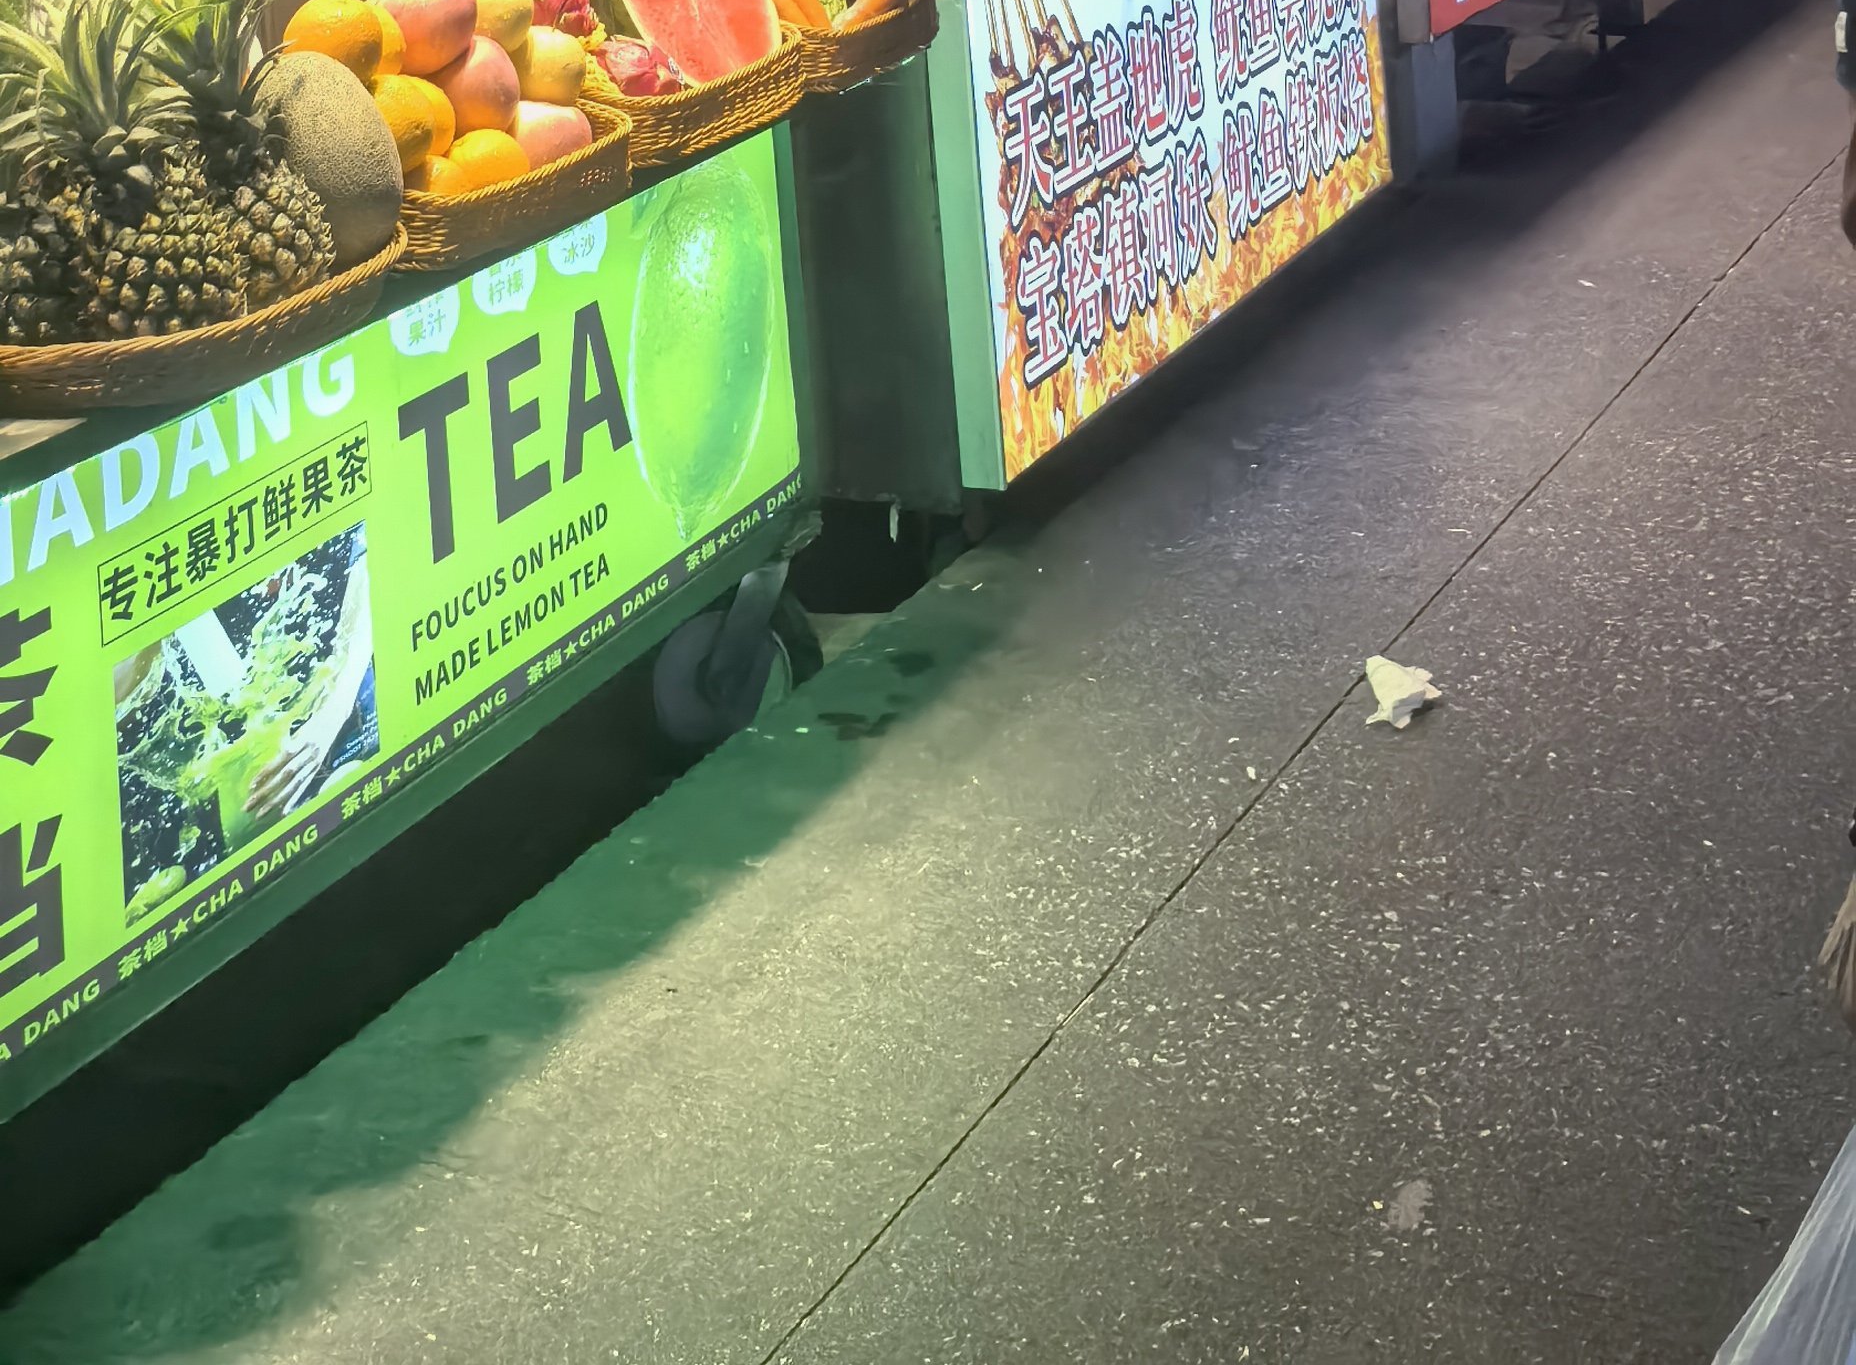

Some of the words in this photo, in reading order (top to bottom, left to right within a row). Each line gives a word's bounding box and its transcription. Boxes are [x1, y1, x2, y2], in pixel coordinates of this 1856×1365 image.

[562, 233, 595, 264] 冰沙
[1018, 127, 1217, 387] 宝塔镇河妖
[1222, 29, 1373, 232] 鱿鱼铁板烧
[408, 309, 446, 347] 果汁
[489, 268, 524, 306] 柠檬
[398, 300, 634, 567] TEA
[102, 435, 369, 621] 专注暴打鲜果茶
[411, 567, 507, 652] FOUCUS
[511, 541, 544, 585] ON
[549, 501, 609, 562] HAND
[415, 643, 481, 706] MADE
[487, 578, 565, 657] LEMON
[569, 553, 610, 598] TEA
[23, 978, 101, 1048] DANG
[117, 929, 168, 981] 茶档
[192, 881, 244, 925] CHA
[253, 822, 320, 884] DANG
[341, 777, 383, 820] 茶档
[403, 734, 446, 773] CHA
[452, 687, 508, 738] DANG
[526, 649, 563, 687] 茶档
[578, 613, 616, 648] CHA
[621, 573, 670, 617] DANG
[685, 537, 718, 571] 茶档
[730, 507, 761, 539] CHA
